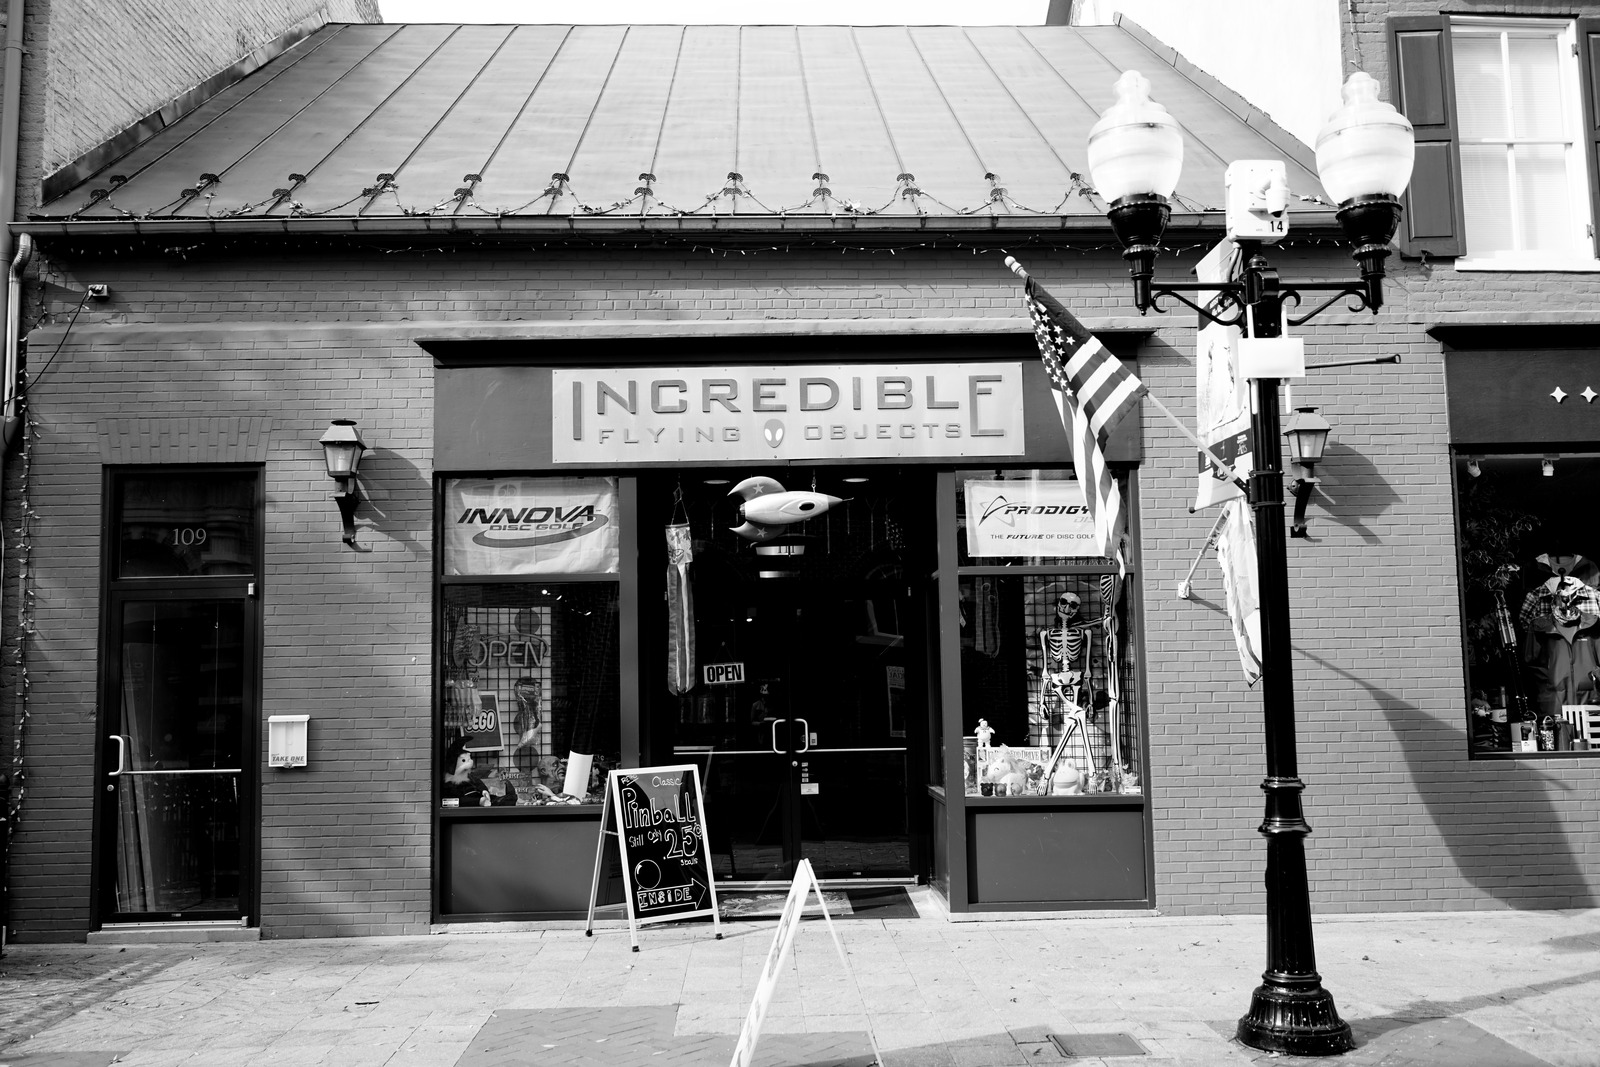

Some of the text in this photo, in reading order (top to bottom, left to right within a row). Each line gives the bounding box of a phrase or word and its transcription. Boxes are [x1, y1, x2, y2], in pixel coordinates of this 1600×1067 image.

[1270, 220, 1284, 233] 14
[572, 374, 1005, 441] INCREDIBLE
[598, 423, 961, 444] FLYING OBJECTS
[457, 504, 595, 525] INNOVA
[535, 522, 584, 531] GOLF
[171, 527, 207, 546] 109
[706, 663, 743, 683] OPEN
[467, 711, 496, 731] EGO
[652, 776, 683, 788] Classic
[629, 834, 644, 848] Still
